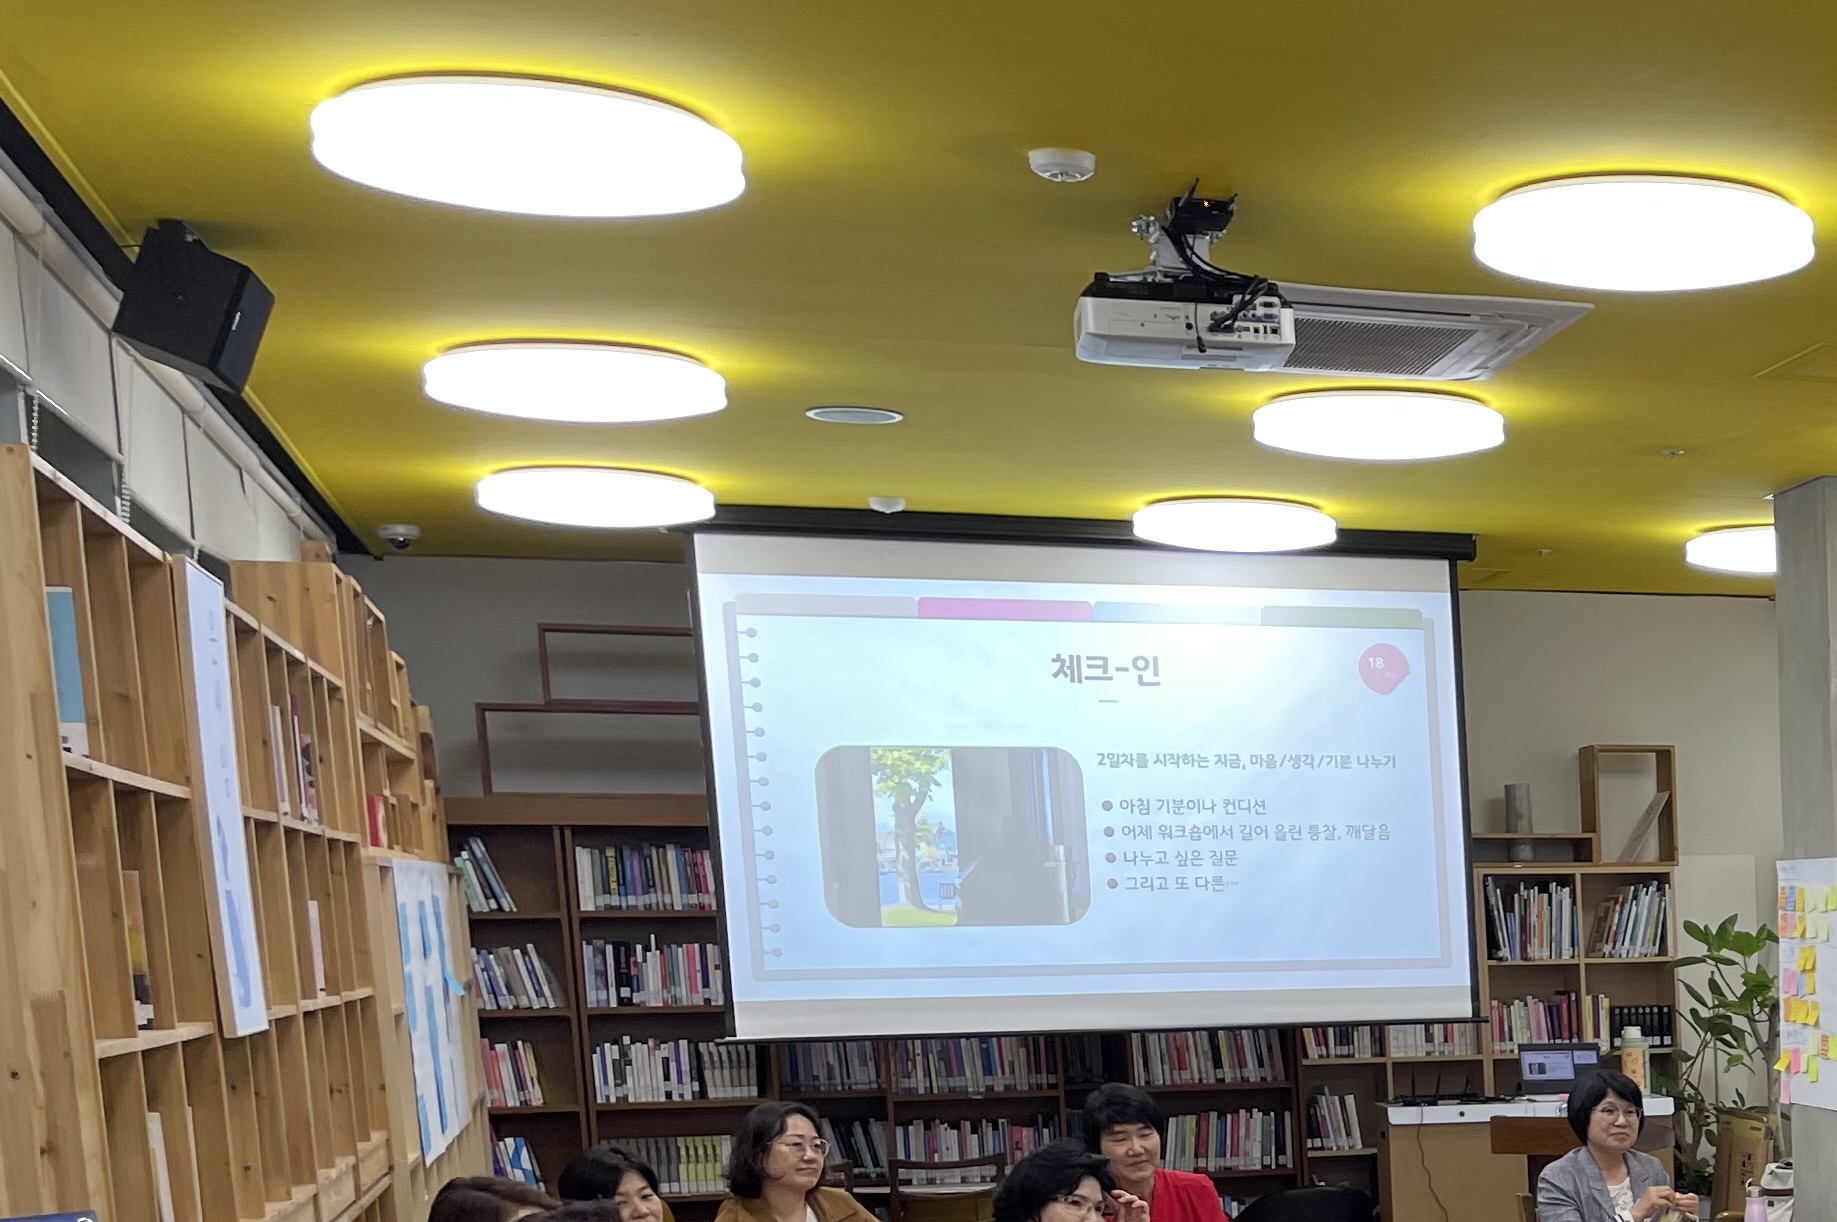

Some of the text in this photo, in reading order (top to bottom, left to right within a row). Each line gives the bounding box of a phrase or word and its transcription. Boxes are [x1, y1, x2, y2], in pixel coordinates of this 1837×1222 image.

[1051, 653, 1161, 687] 체크-인
[1368, 656, 1384, 669] 18
[1096, 752, 1149, 769] 2일차를
[1153, 753, 1210, 769] 시작하는
[1214, 753, 1246, 770] 지금,
[1356, 754, 1397, 769] 나누기
[1119, 798, 1267, 816] 아침 기분이나 컨디션
[1121, 824, 1391, 841] 어제 워크숍에서 길어 올린 통찰, 깨달음
[1123, 850, 1239, 867] 나누고 싶은 질문
[1125, 876, 1170, 892] 그리고
[1175, 876, 1190, 890] 또
